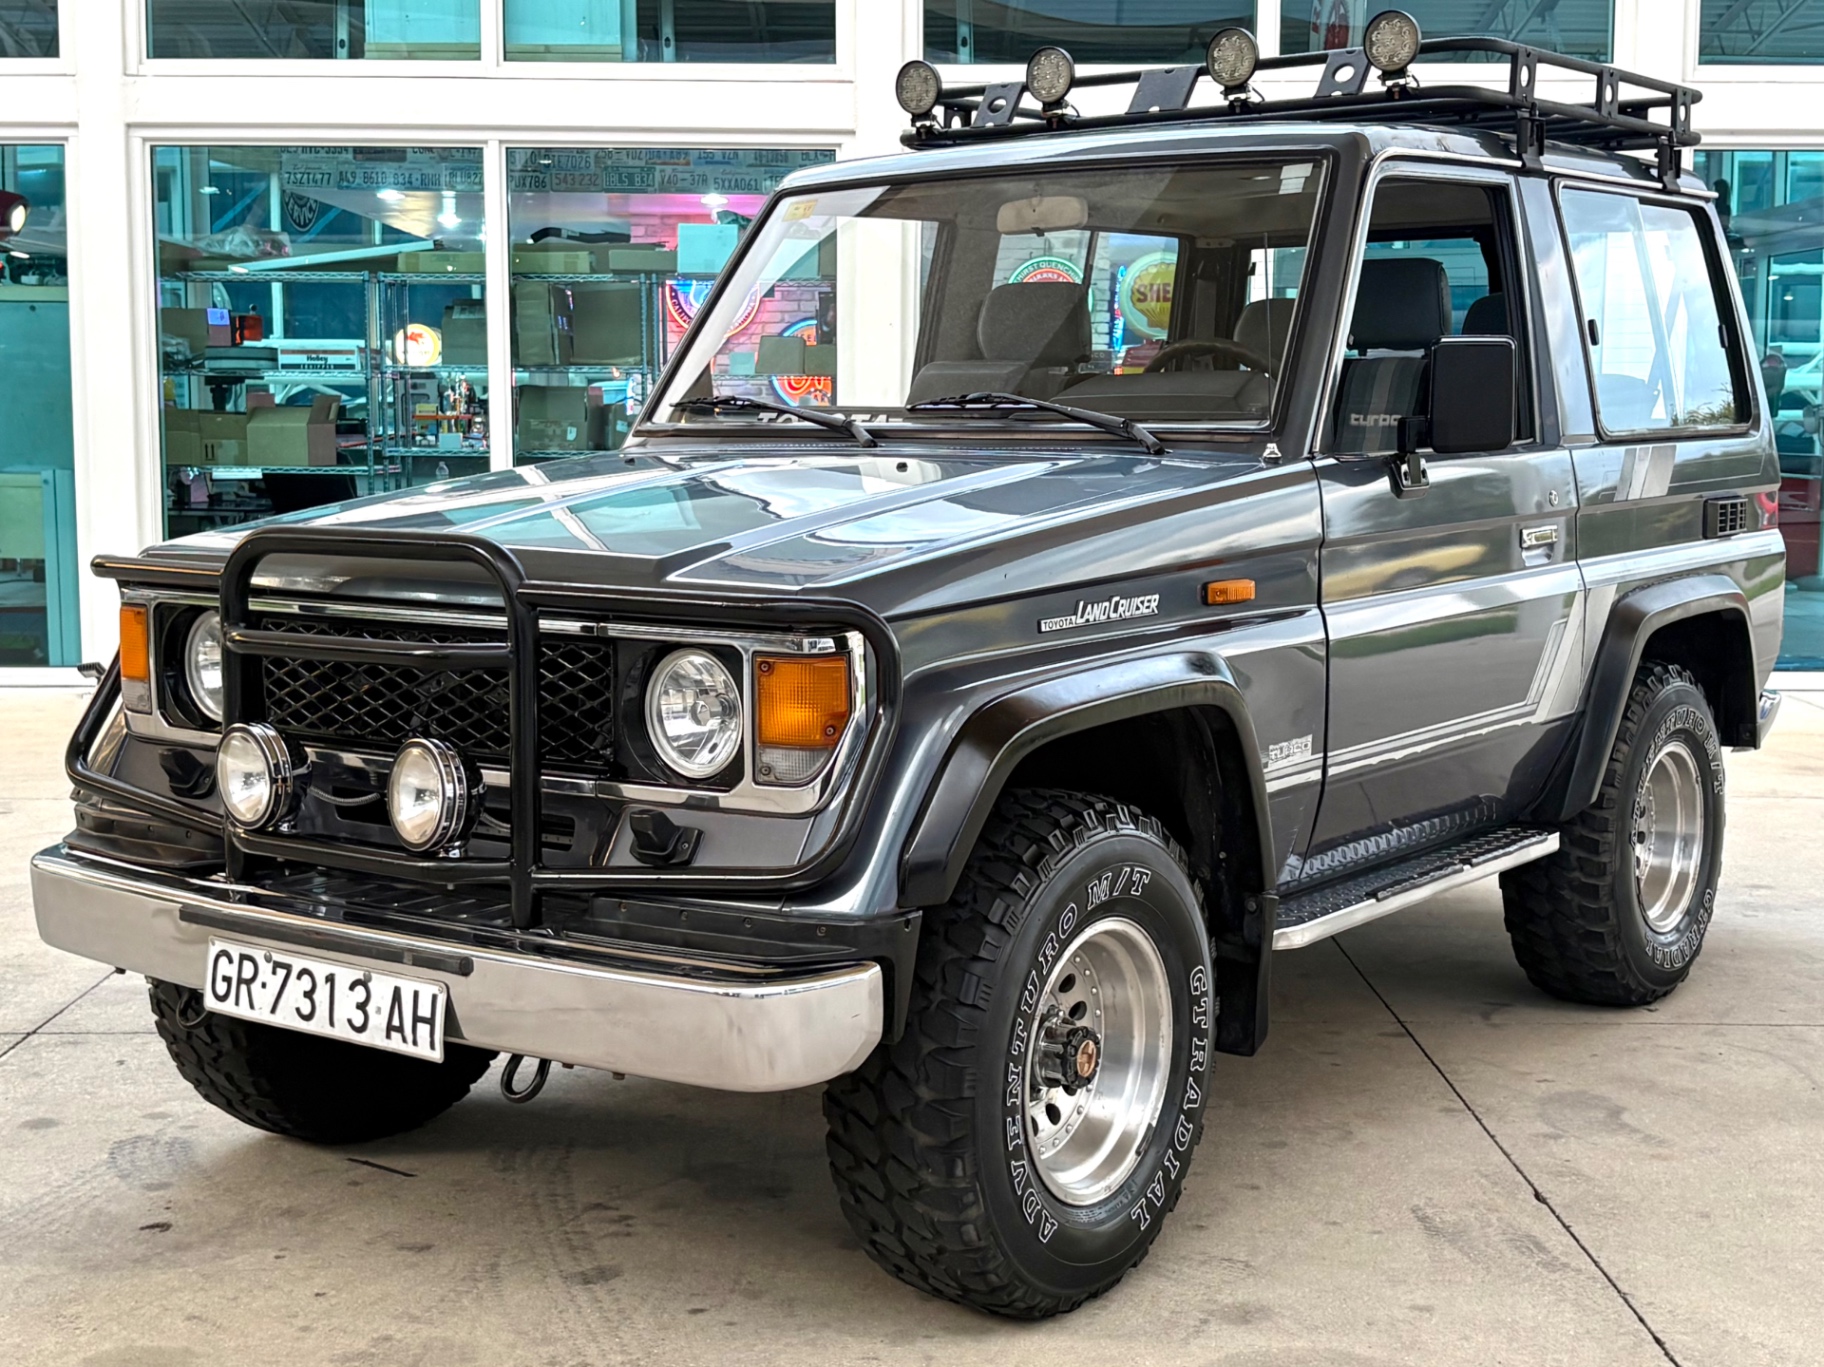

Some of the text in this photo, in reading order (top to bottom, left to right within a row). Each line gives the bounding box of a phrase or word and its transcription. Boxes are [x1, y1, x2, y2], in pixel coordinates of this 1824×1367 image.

[306, 354, 329, 365] Holley
[1043, 617, 1074, 631] TOYOTA
[1006, 867, 1152, 1243] ADVENTURO M/T
